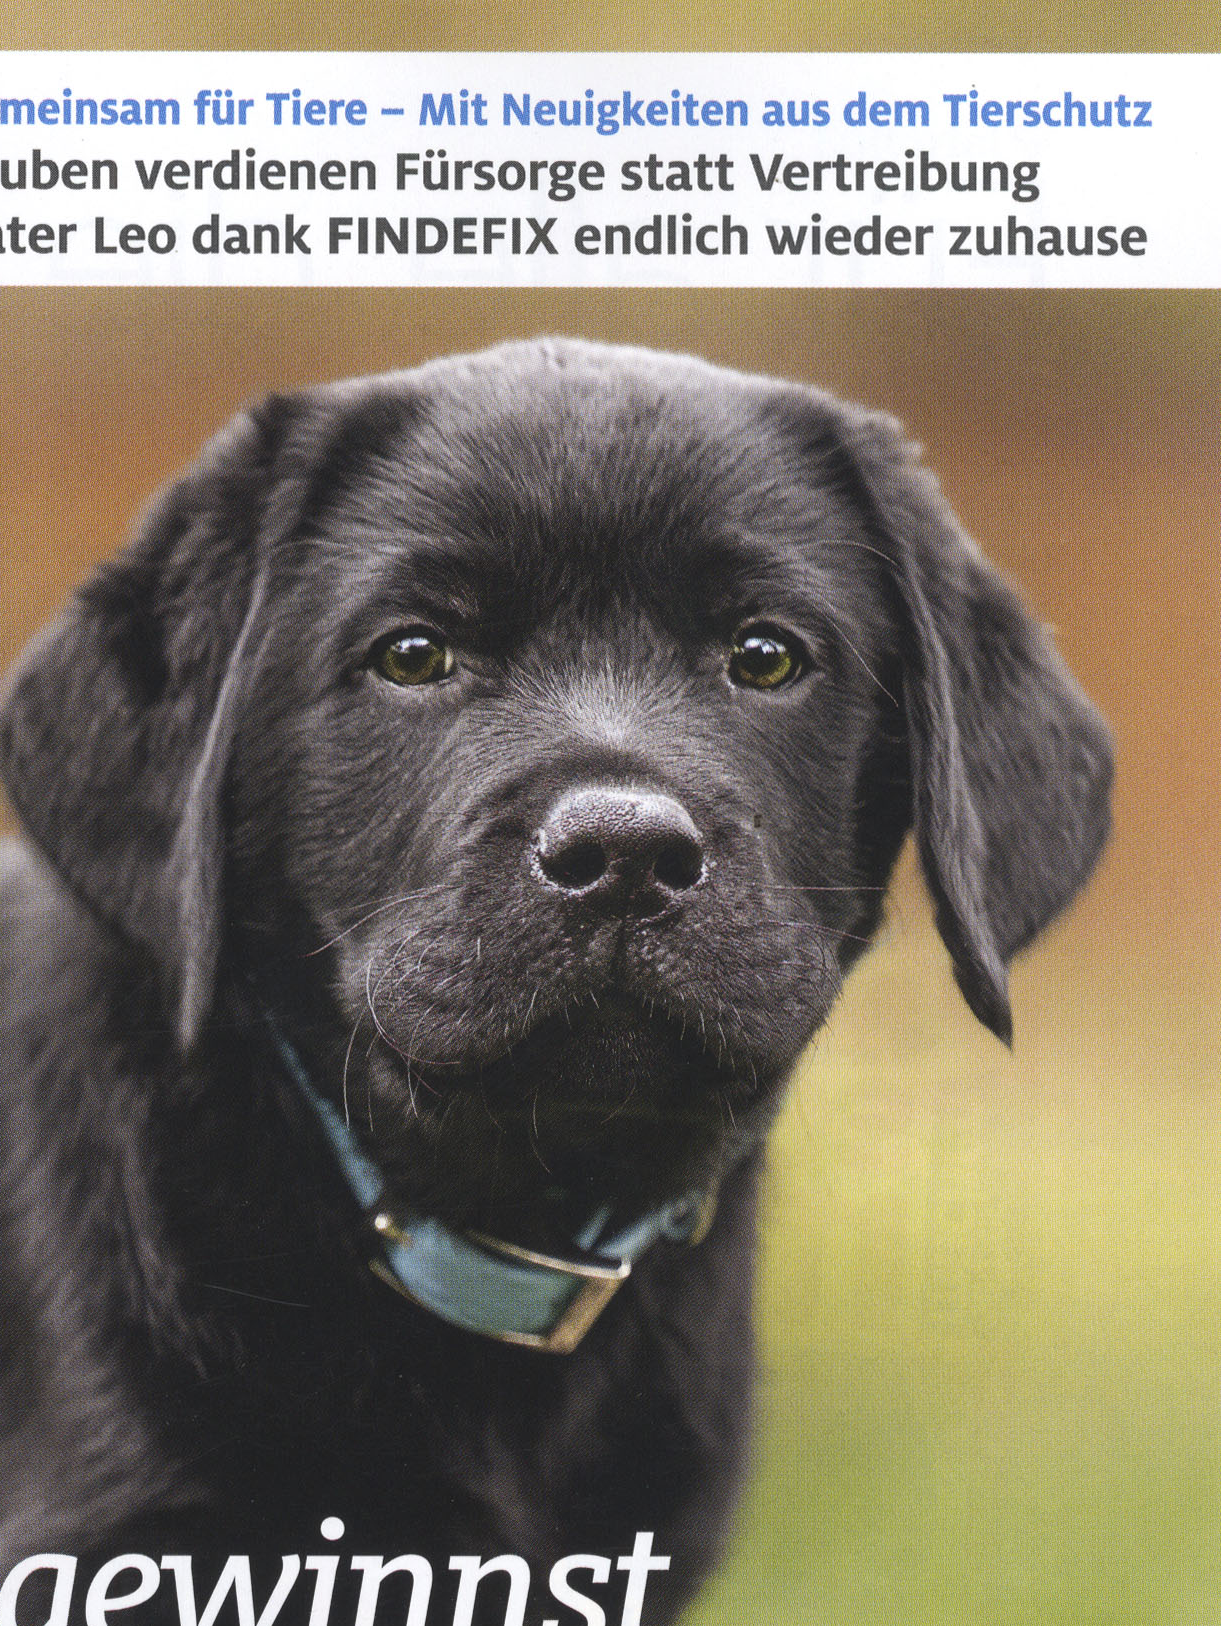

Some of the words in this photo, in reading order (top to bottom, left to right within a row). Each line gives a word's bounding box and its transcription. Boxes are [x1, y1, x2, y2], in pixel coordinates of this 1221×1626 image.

[194, 90, 254, 125] für
[266, 89, 367, 125] Tiere
[420, 89, 487, 126] Mit
[503, 89, 748, 136] Neuigkeiten
[762, 101, 830, 127] aus
[844, 92, 929, 127] dem
[943, 90, 1152, 127] Tierschutz
[135, 148, 376, 190] verdienen
[397, 149, 605, 201] Fürsorge
[621, 154, 734, 191] statt
[750, 149, 1040, 202] Vertreibung
[95, 217, 176, 254] Leo
[193, 214, 311, 254] dank
[329, 217, 558, 254] FINDEFIX
[575, 213, 748, 255] endlich
[766, 213, 933, 255] wieder
[949, 216, 1147, 256] zuhause
